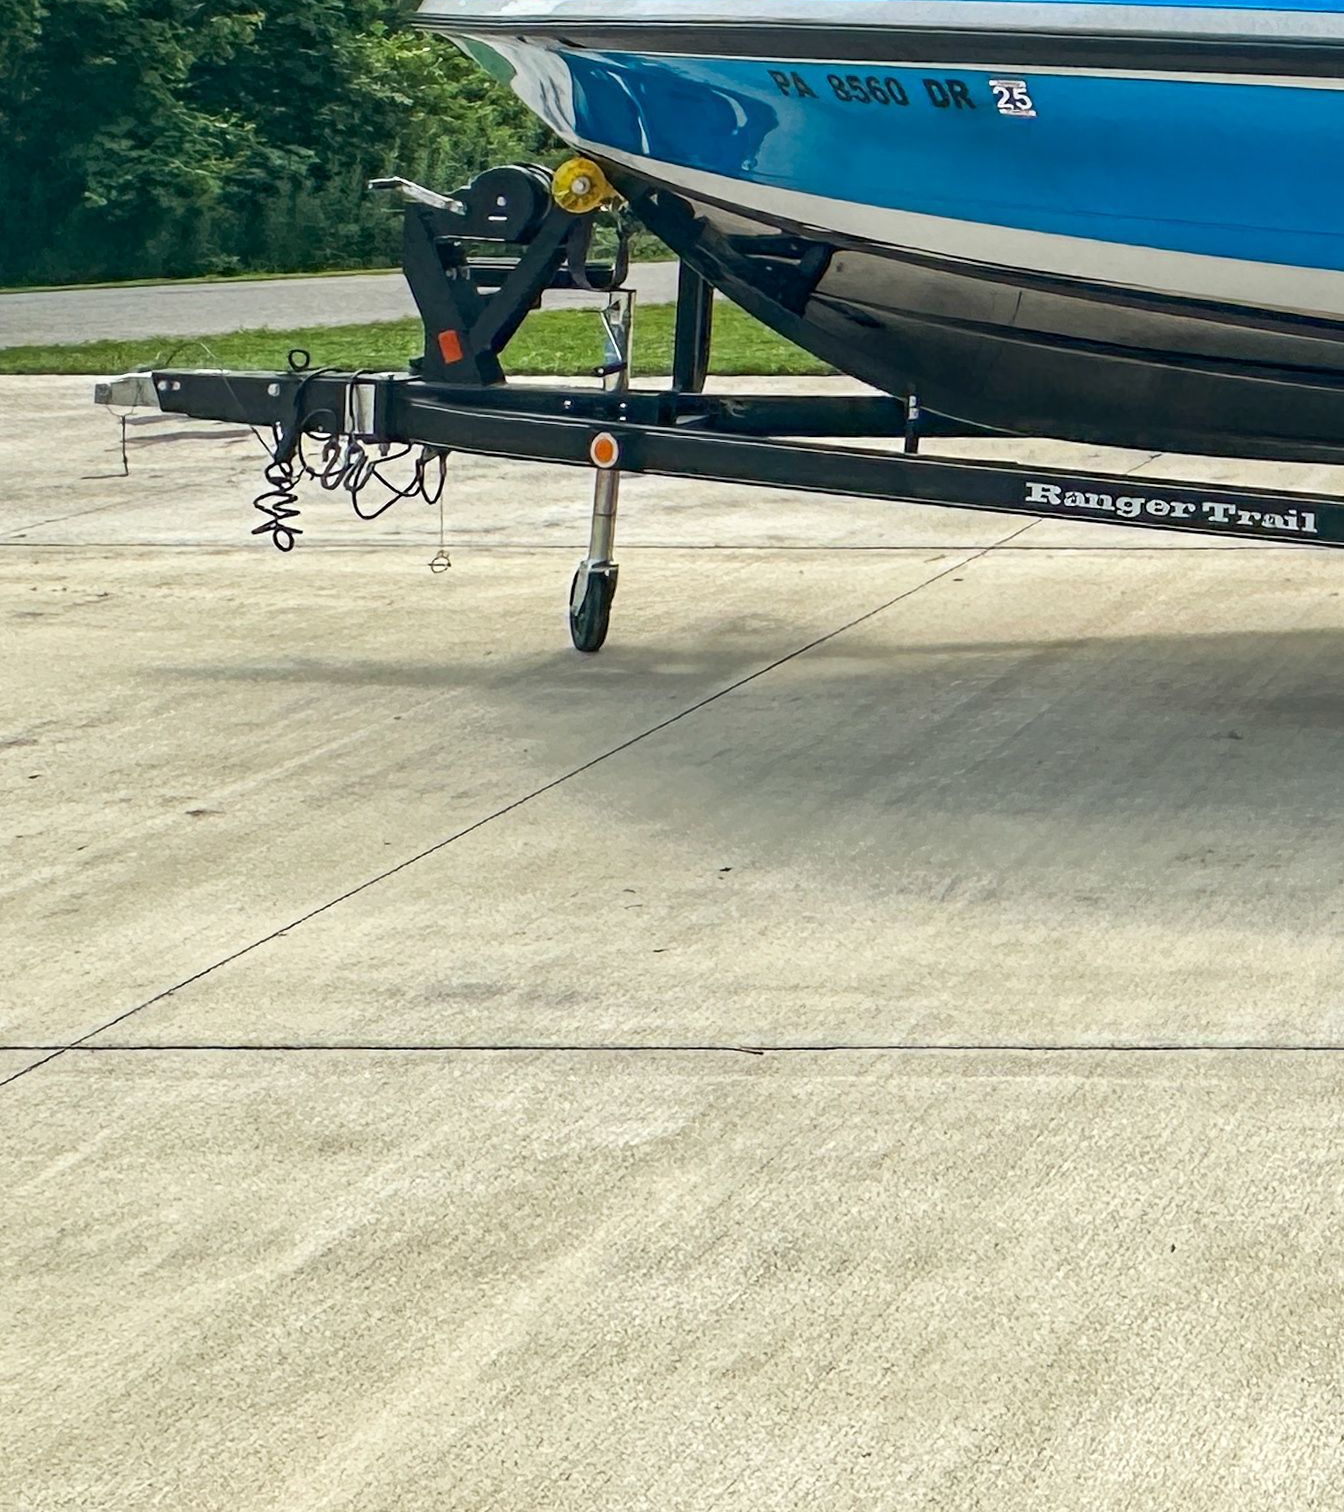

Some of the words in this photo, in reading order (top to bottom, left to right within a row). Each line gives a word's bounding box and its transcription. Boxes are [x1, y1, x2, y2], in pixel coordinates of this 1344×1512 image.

[767, 69, 818, 99] PA
[826, 73, 910, 107] 8560
[922, 78, 977, 110] DR
[992, 85, 1033, 111] 25
[1024, 482, 1196, 518] Ranger
[1202, 501, 1318, 533] Trail
